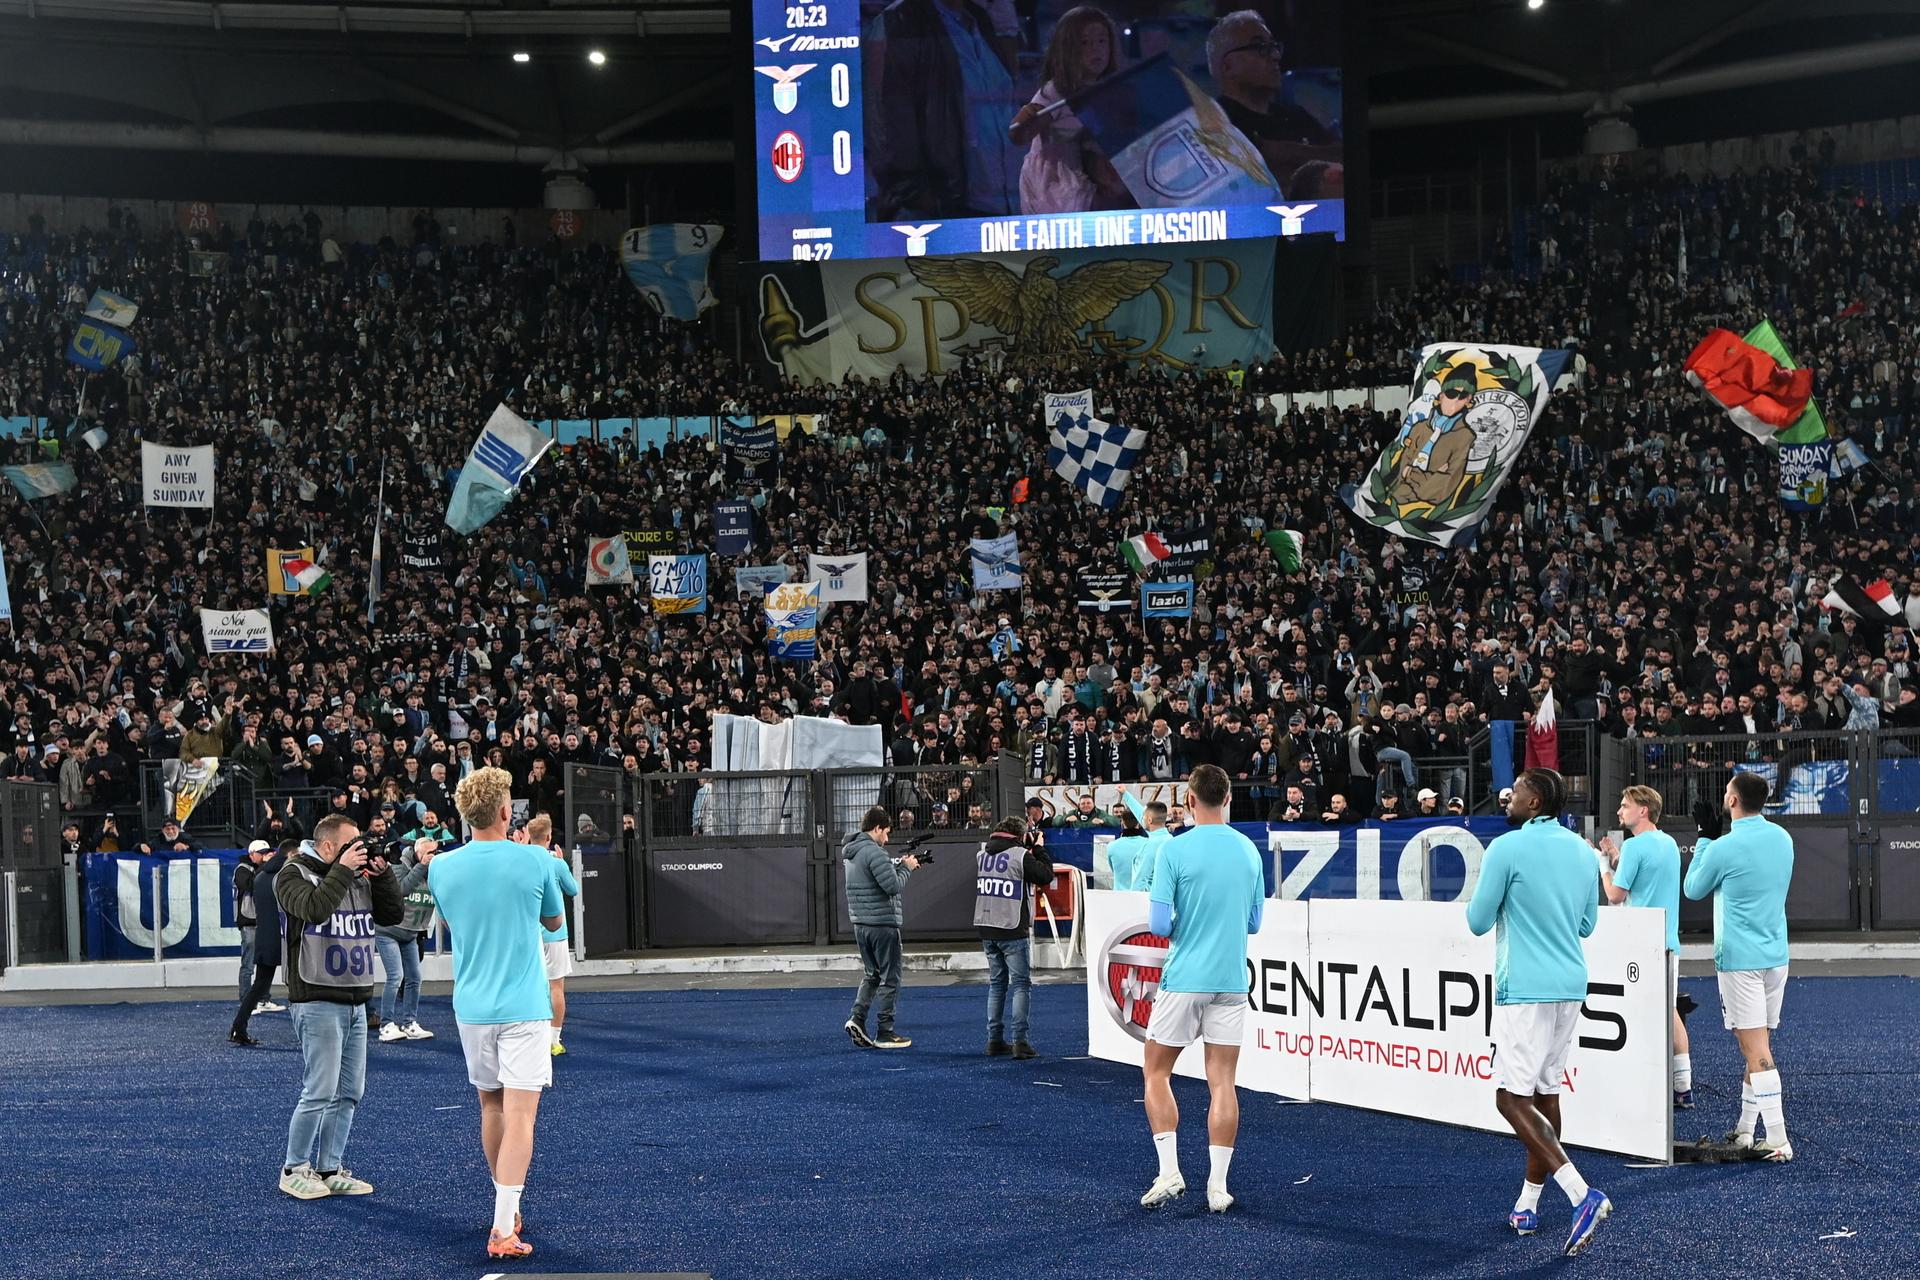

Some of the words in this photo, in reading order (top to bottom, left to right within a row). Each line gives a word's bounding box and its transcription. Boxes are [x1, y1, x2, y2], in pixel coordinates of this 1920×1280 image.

[786, 5, 827, 28] 20:23
[831, 63, 849, 108] 0
[833, 130, 851, 175] 0
[980, 221, 1021, 253] ONE
[1095, 214, 1136, 247] ONE
[1141, 209, 1227, 243] PASSION
[733, 447, 771, 458] IMMENSO
[1778, 444, 1831, 465] SUNDAY
[165, 454, 191, 466] ANY
[161, 471, 197, 484] GIVEN
[153, 489, 205, 502] SUNDAY
[405, 533, 437, 546] LAZIO
[1163, 539, 1208, 553] OMANI
[403, 554, 441, 568] TEQUILA
[652, 559, 700, 576] C'MON
[652, 576, 703, 595] LAZIO
[1151, 596, 1184, 606] lazio
[1397, 591, 1429, 604] LAZIO
[221, 612, 246, 626] Noi
[208, 626, 241, 636] siamo
[246, 626, 267, 638] qua
[1860, 799, 1868, 812] 4
[661, 863, 687, 871] STADIO
[688, 862, 723, 870] OLIMPICO
[977, 879, 1014, 897] HOTO
[325, 944, 374, 977] 091
[1247, 957, 1627, 1052] ENTALPS
[1257, 1028, 1270, 1049] IL
[1275, 1031, 1313, 1057] TUO
[1319, 1035, 1421, 1071] PARTNER
[1428, 1048, 1447, 1074] DI
